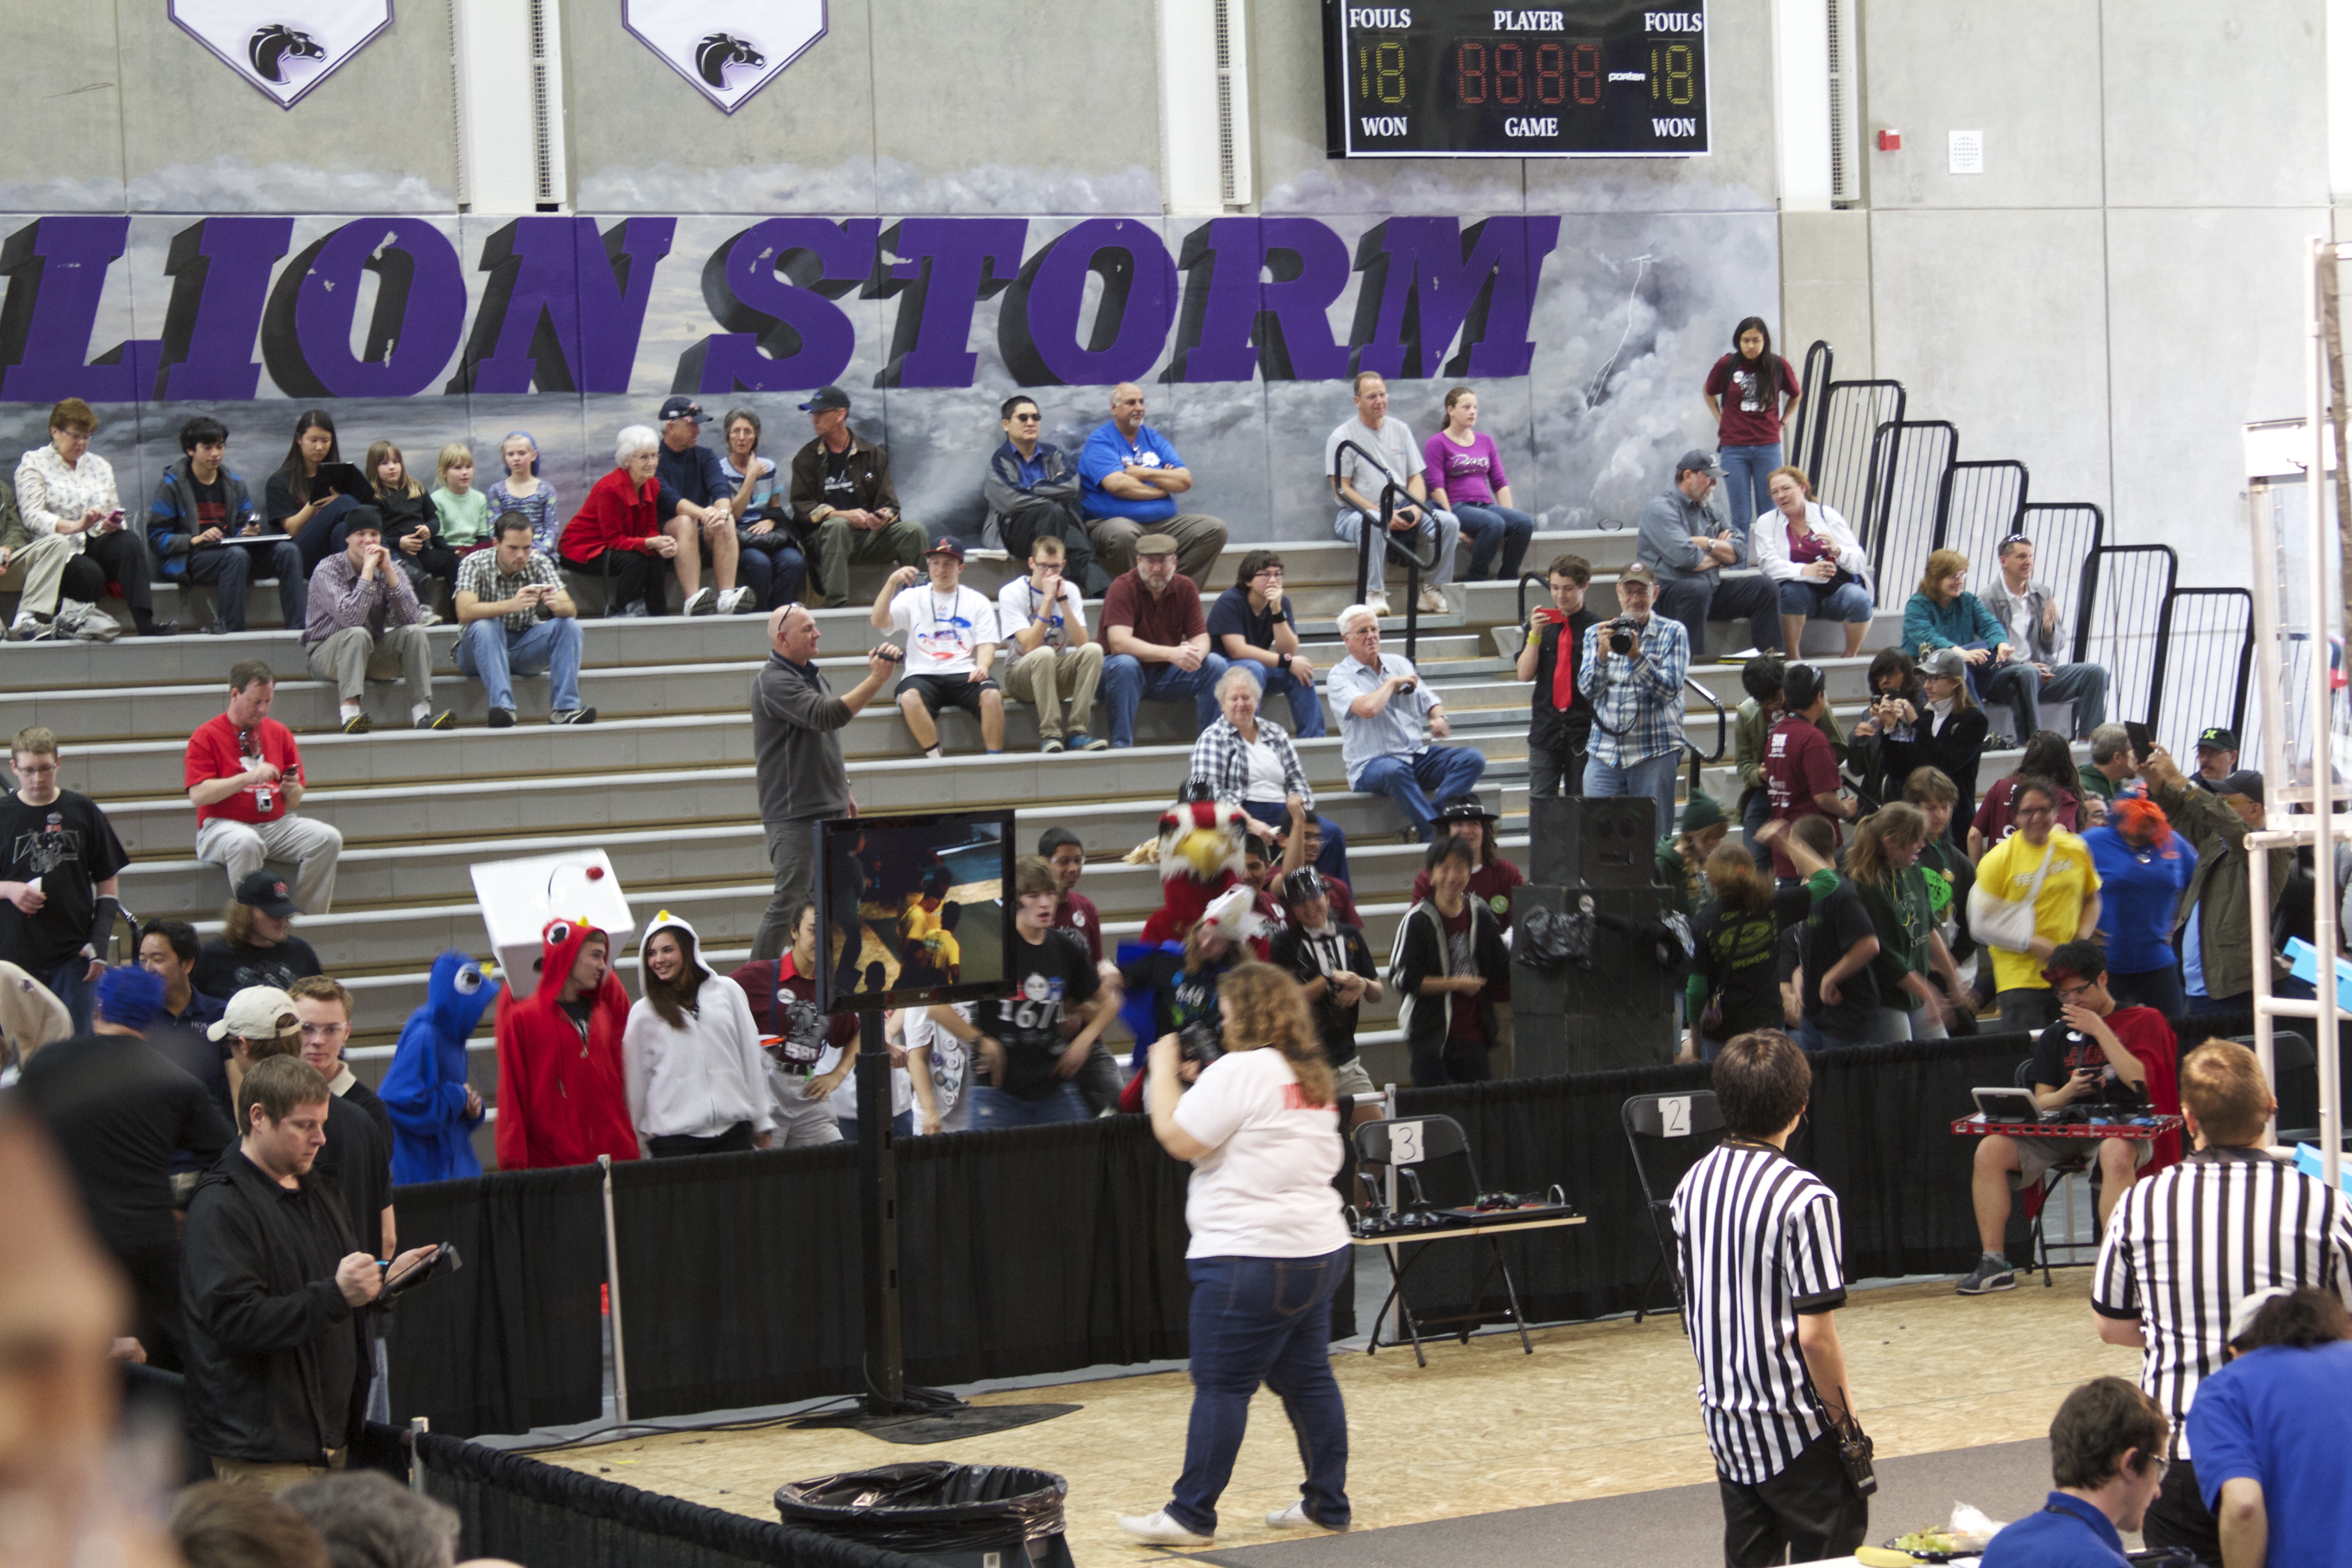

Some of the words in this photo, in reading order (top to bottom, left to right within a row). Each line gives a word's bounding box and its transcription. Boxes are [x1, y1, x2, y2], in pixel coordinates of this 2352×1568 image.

[1349, 8, 1411, 29] FOULS
[1493, 10, 1565, 31] PLAYER
[1644, 12, 1703, 32] FOULS
[1361, 117, 1407, 137] WON
[1504, 117, 1558, 137] GAME
[1651, 118, 1696, 137] WON
[1, 217, 677, 402] LION
[700, 216, 1561, 393] STORM
[1669, 1100, 1685, 1131] 2
[1398, 1127, 1416, 1160] 3
